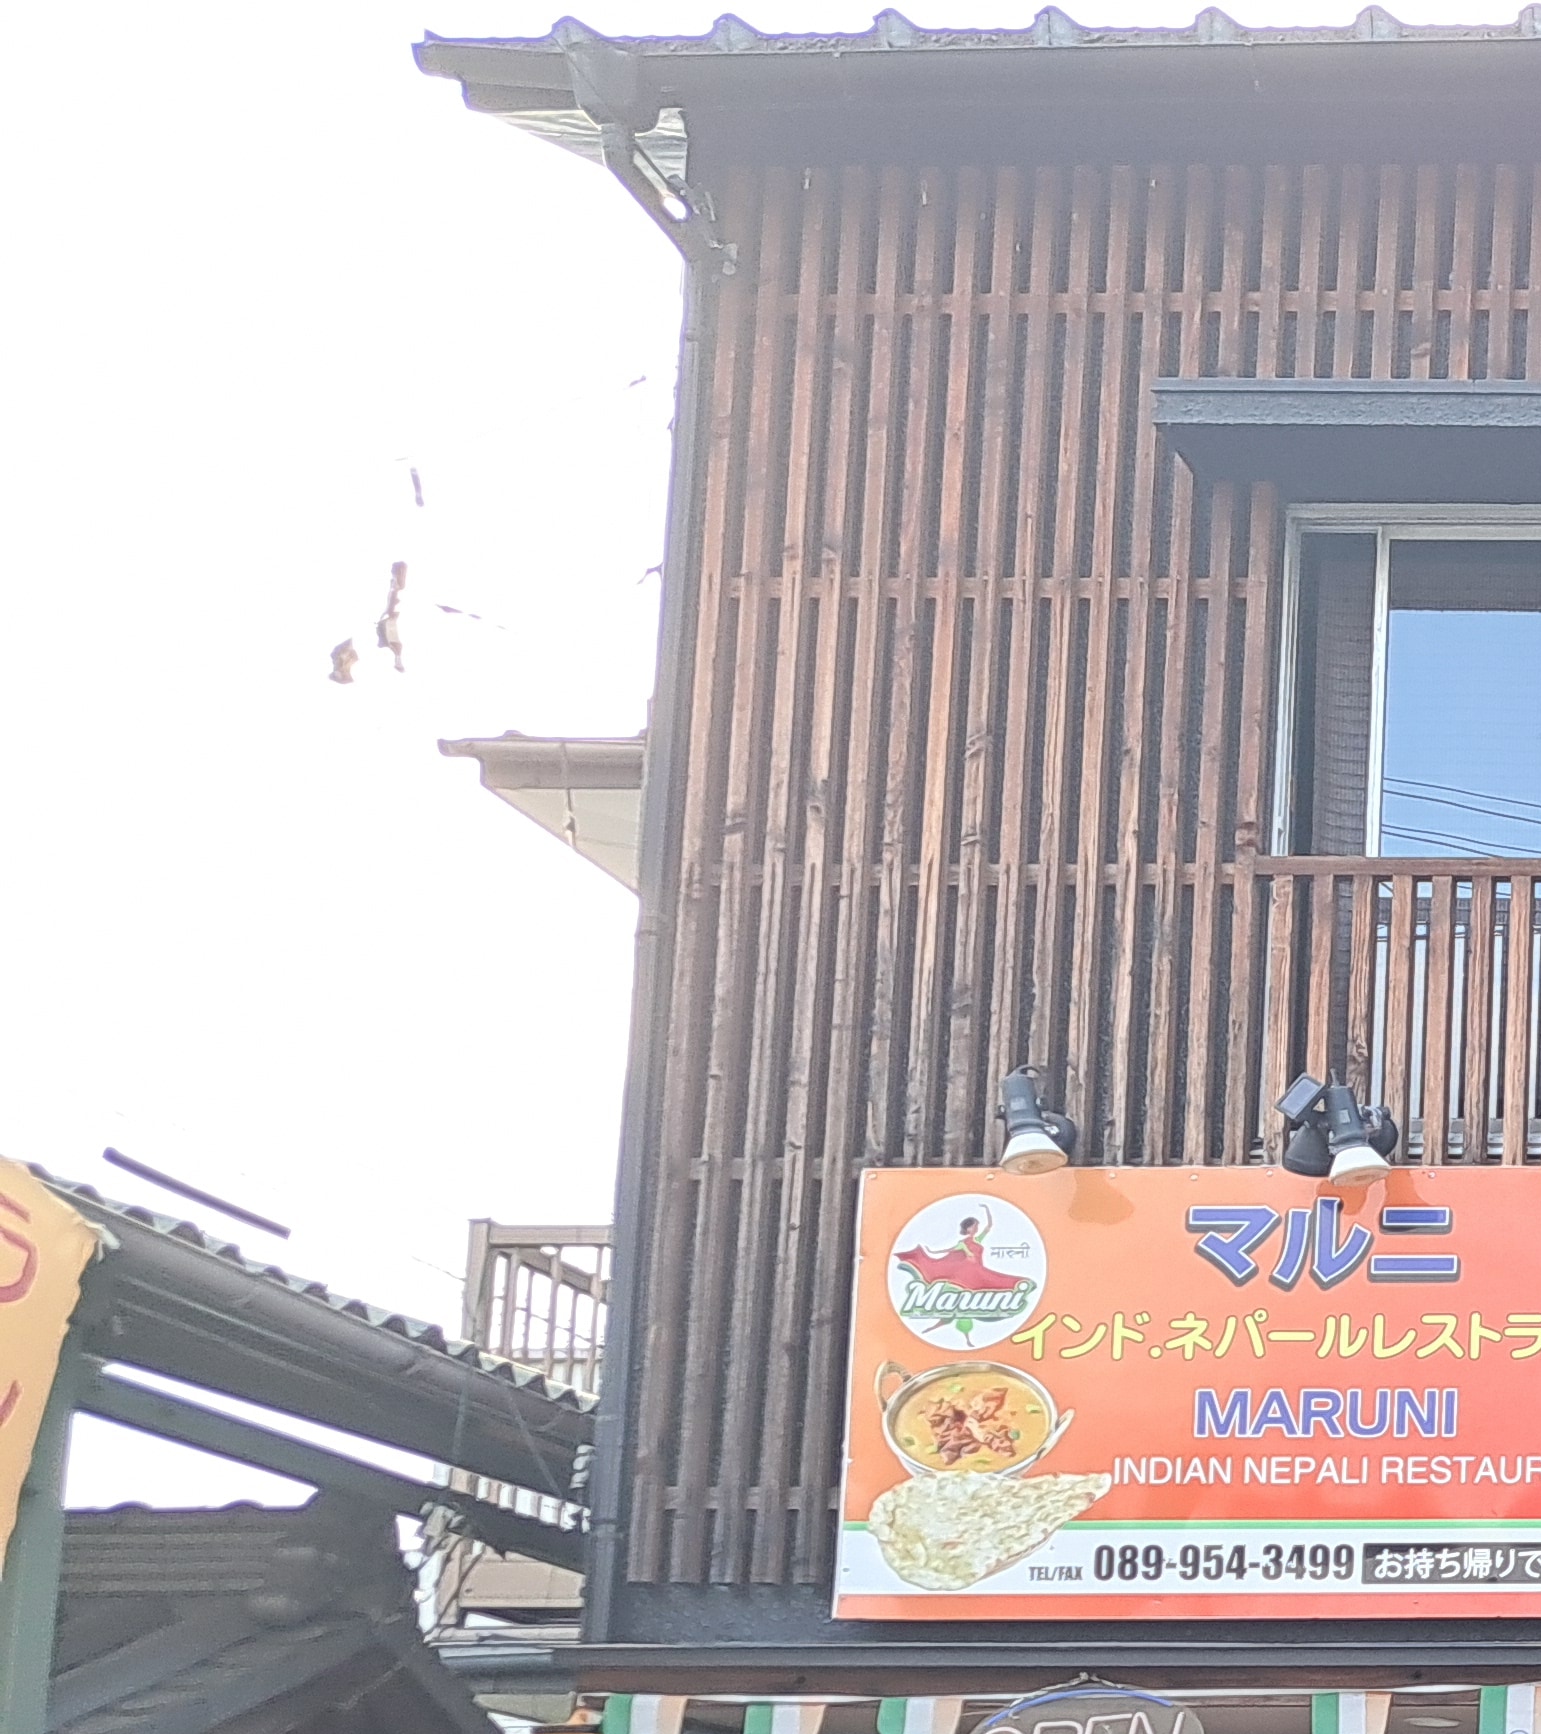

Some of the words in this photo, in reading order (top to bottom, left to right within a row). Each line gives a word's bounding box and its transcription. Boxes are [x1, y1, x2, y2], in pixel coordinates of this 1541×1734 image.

[1185, 1196, 1461, 1290] マルニ
[902, 1279, 1029, 1313] Maruni
[1193, 1386, 1459, 1440] MARUNI
[1112, 1457, 1234, 1488] INDIAN
[1244, 1456, 1369, 1487] NEPALI
[1027, 1564, 1084, 1582] TEL/FAX
[1093, 1543, 1355, 1582] 089-954-3499
